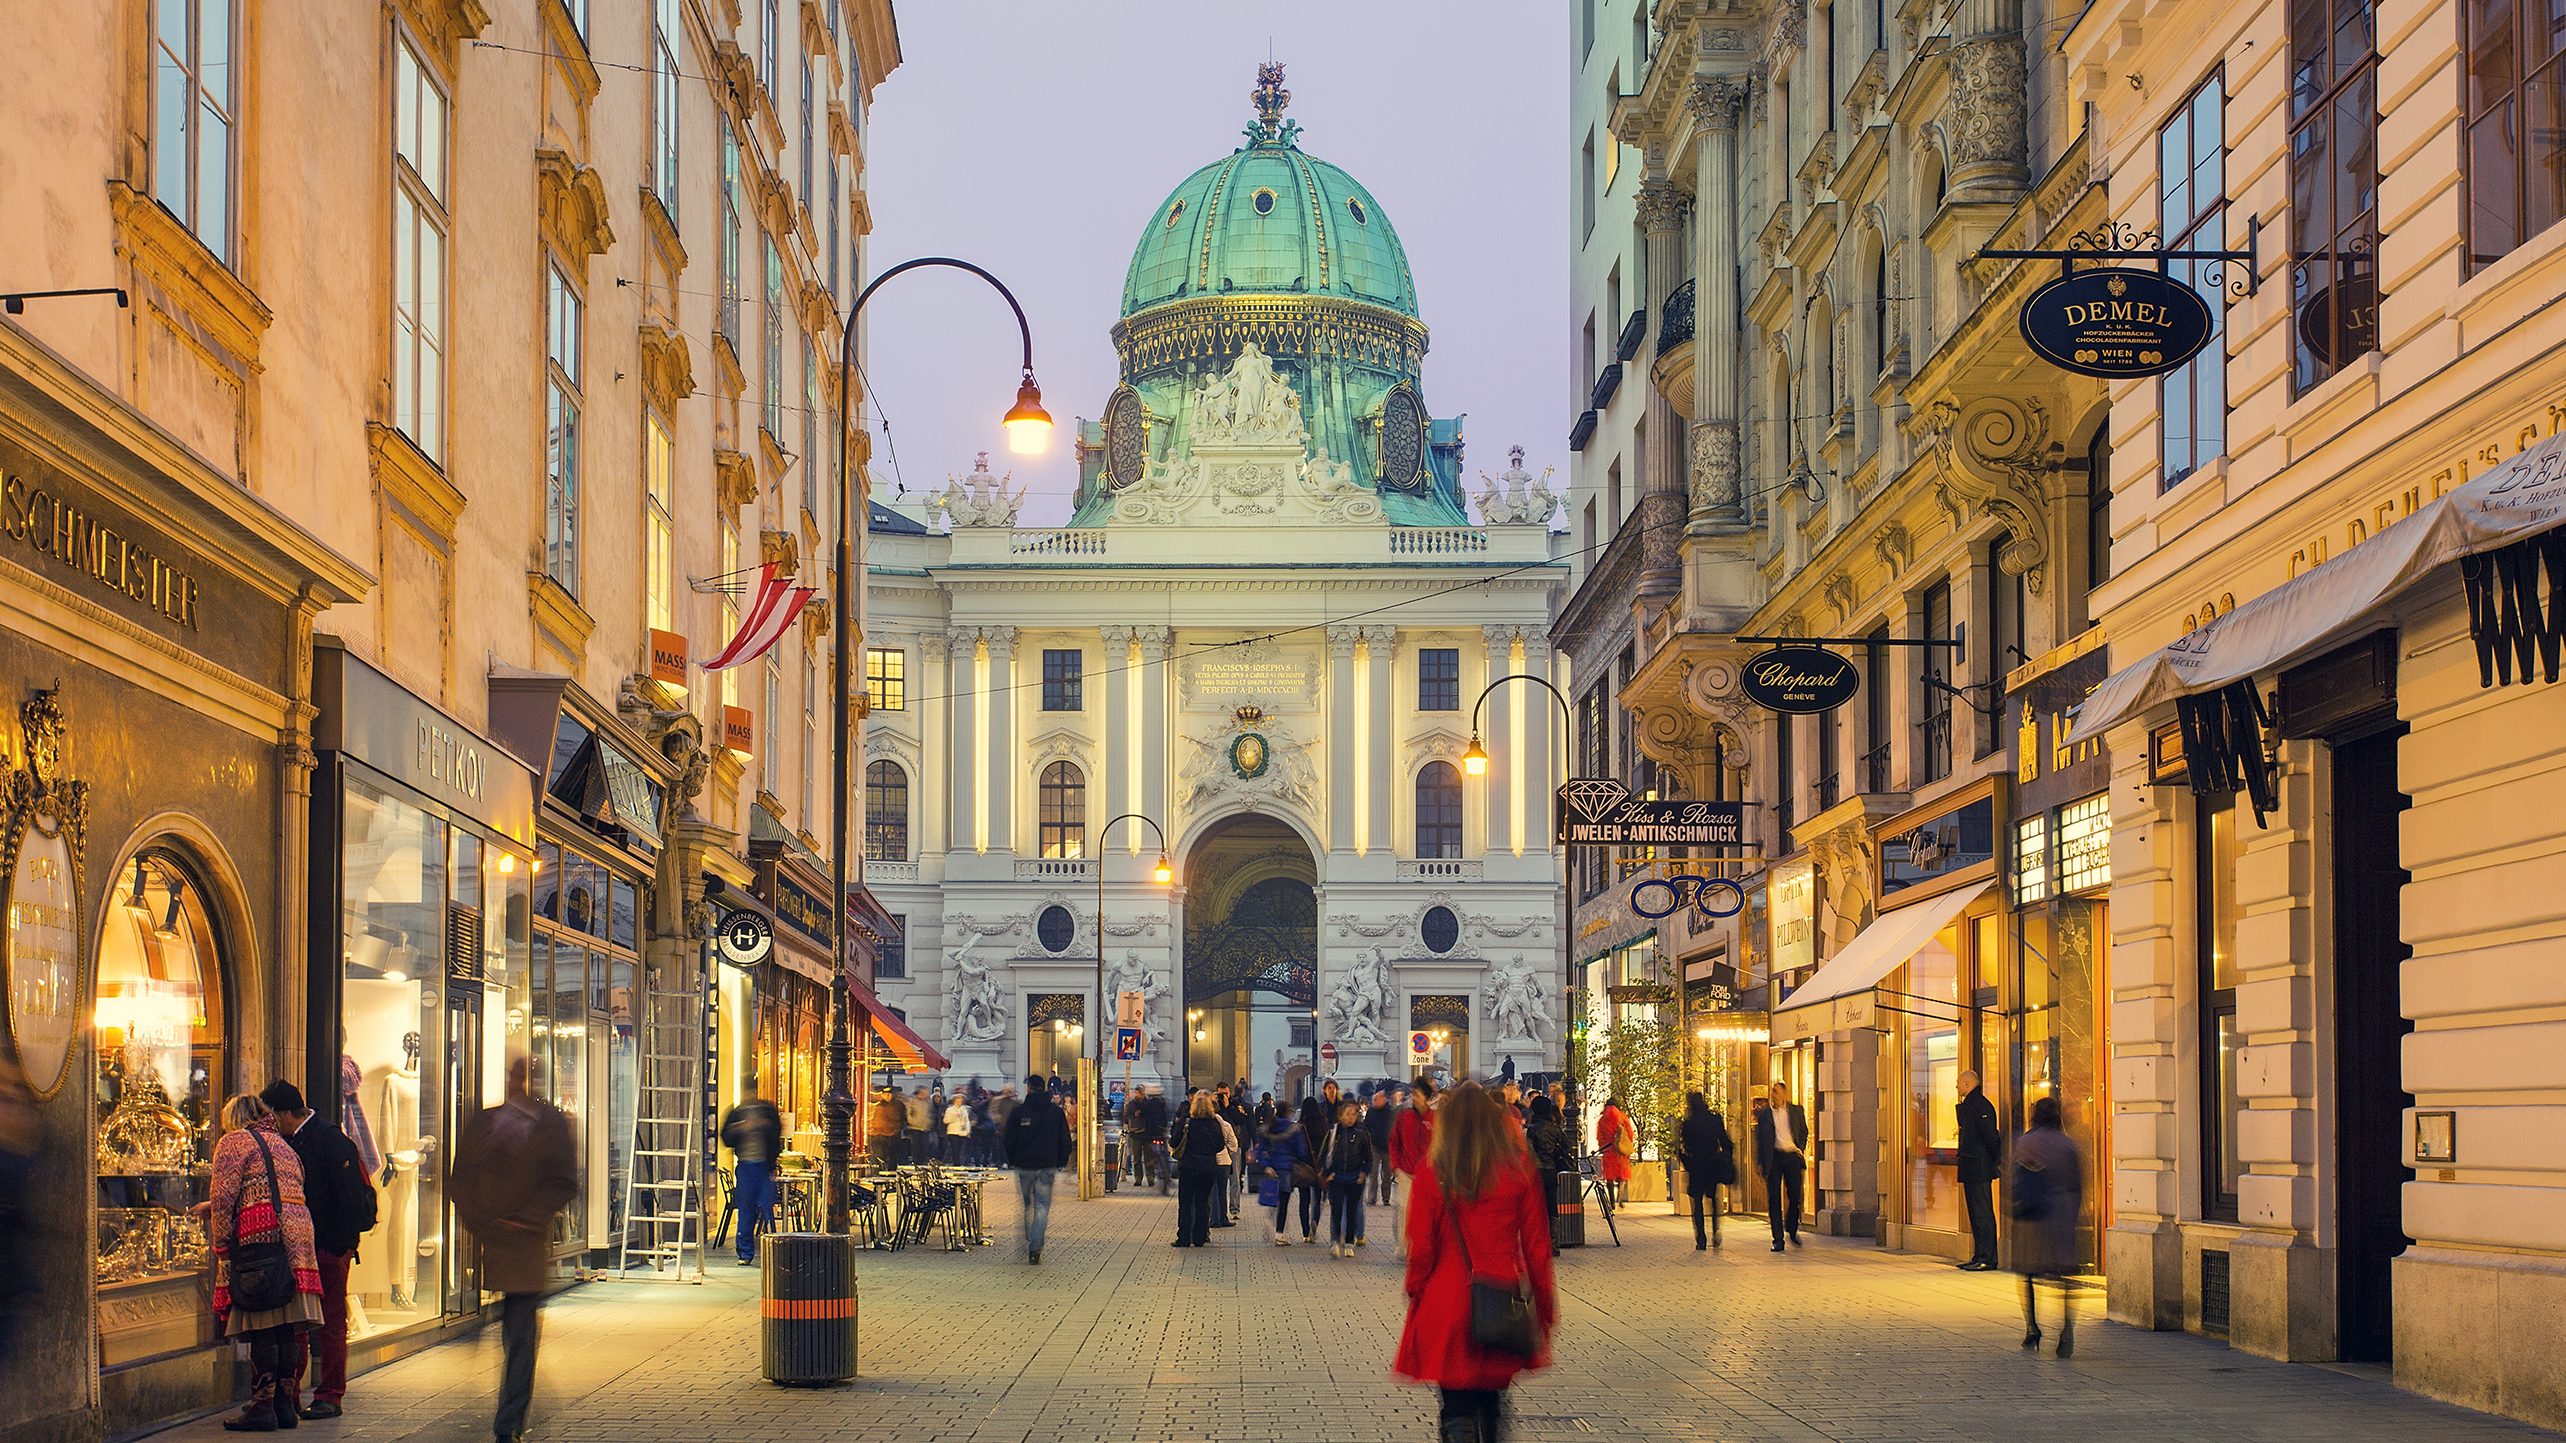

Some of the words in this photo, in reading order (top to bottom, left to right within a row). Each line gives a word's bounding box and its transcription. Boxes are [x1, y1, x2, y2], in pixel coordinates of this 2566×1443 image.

[2064, 301, 2173, 328] DEMEL
[2102, 349, 2133, 357] WIEN
[1202, 664, 1250, 672] FRANCISCVS
[1253, 664, 1291, 672] IOSEPHVS
[1753, 662, 1845, 691] Chopard
[417, 717, 487, 803] PETKOV
[1614, 801, 1655, 824] Kiss
[1659, 810, 1675, 824] &
[1630, 825, 1737, 842] ANTIKSCHMUCK
[721, 912, 769, 935] HEISSENBERGER
[721, 936, 770, 960] HEISSENBERGER
[1710, 991, 1731, 1000] FORD
[1711, 984, 1728, 993] TOM
[1413, 1055, 1430, 1063] Zone
